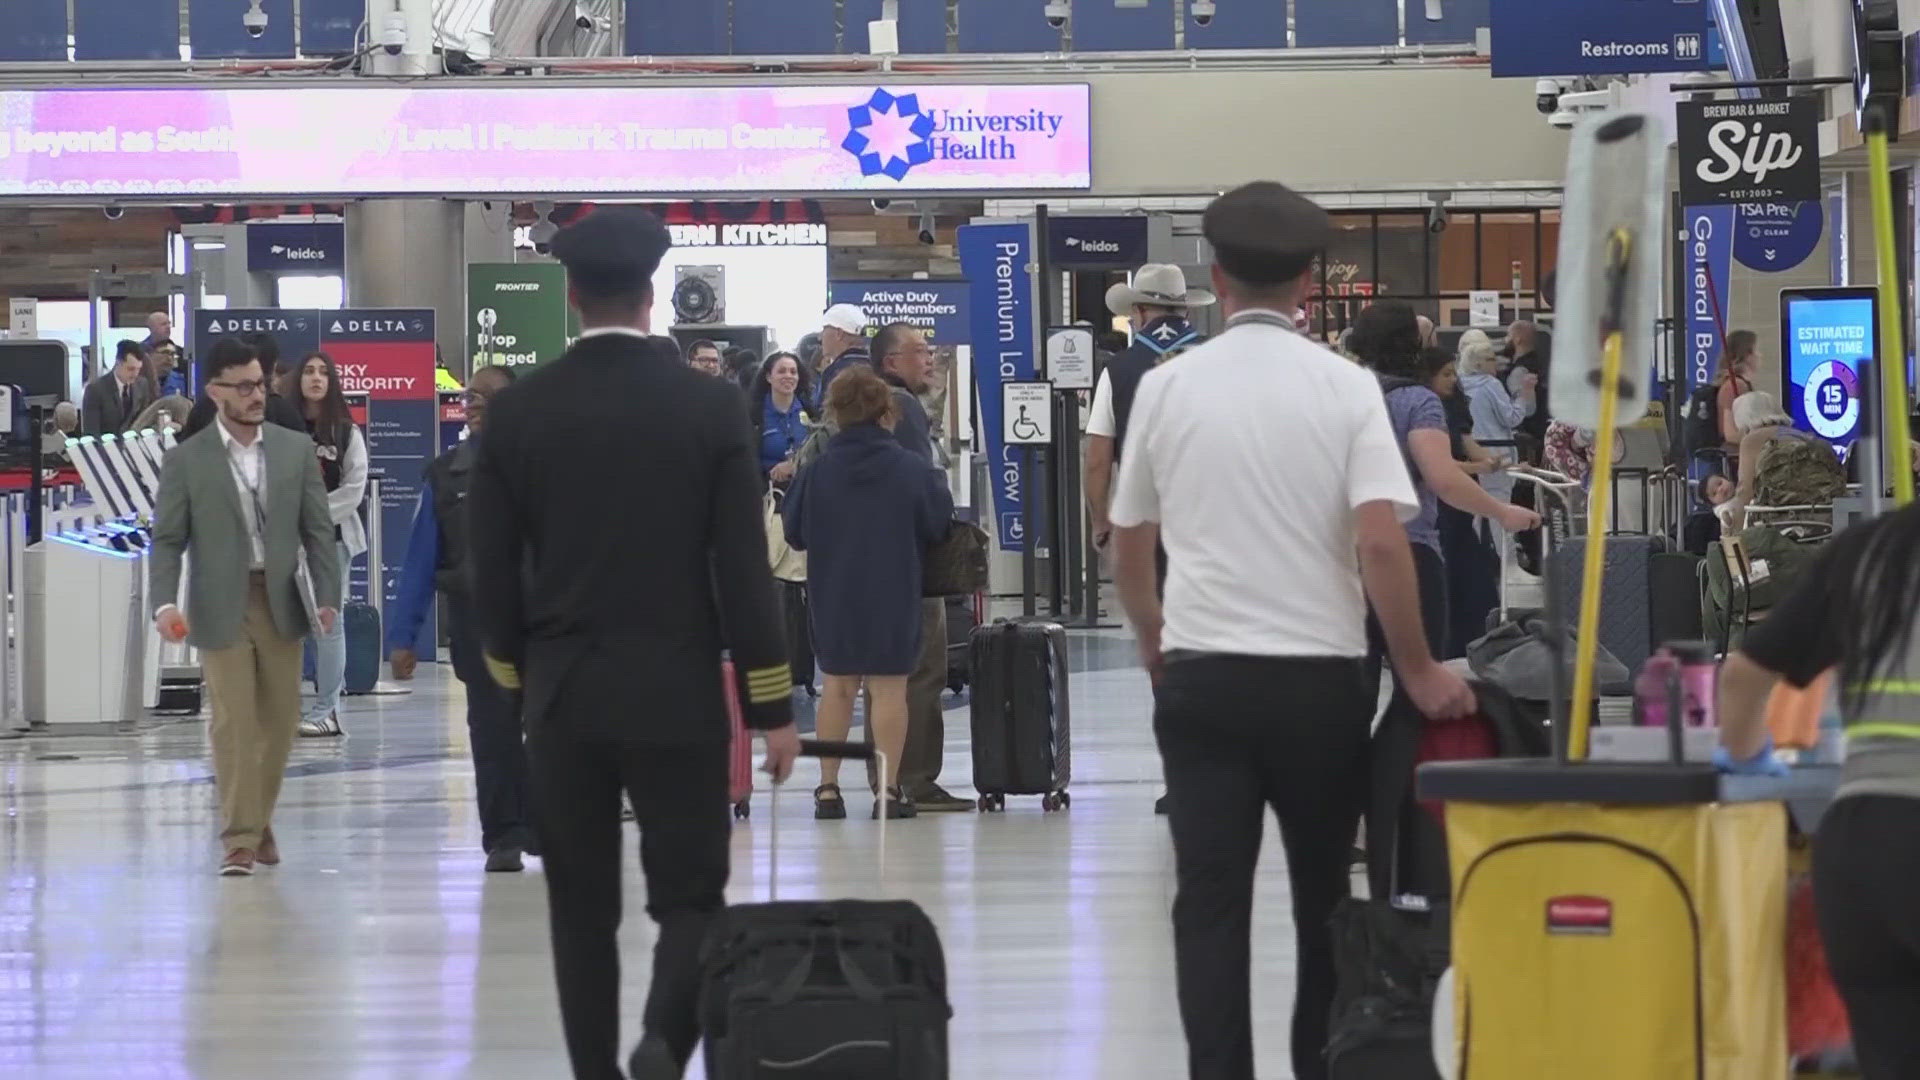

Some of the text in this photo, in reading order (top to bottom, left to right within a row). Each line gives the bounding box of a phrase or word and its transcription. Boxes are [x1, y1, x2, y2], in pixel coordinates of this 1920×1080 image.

[1581, 40, 1669, 57] Restrooms
[1703, 102, 1791, 118] BREW BAR & MARKET
[929, 108, 1063, 138] University
[15, 125, 116, 157] beyond
[621, 122, 728, 151] Trauma
[930, 135, 1016, 160] Health
[1696, 120, 1803, 184] Sip
[1739, 203, 1789, 216] TSA Pre
[664, 222, 827, 246] ERN KITCHEN
[286, 247, 325, 260] leidos
[1081, 239, 1119, 252] leidos
[1694, 215, 1713, 321] General
[494, 282, 540, 292] FRONTIER
[996, 242, 1019, 342] Premium
[862, 291, 939, 305] Active Duty
[860, 302, 957, 315] rvice Members
[227, 318, 289, 333] DELTA
[348, 319, 407, 333] DELTA
[881, 314, 936, 327] Uniform
[477, 332, 517, 348] Drop
[1797, 325, 1865, 341] ESTIMATED
[1800, 341, 1864, 355] WAIT TIME
[334, 363, 368, 377] SKY
[1822, 384, 1842, 404] 15
[1823, 404, 1842, 415] MIN
